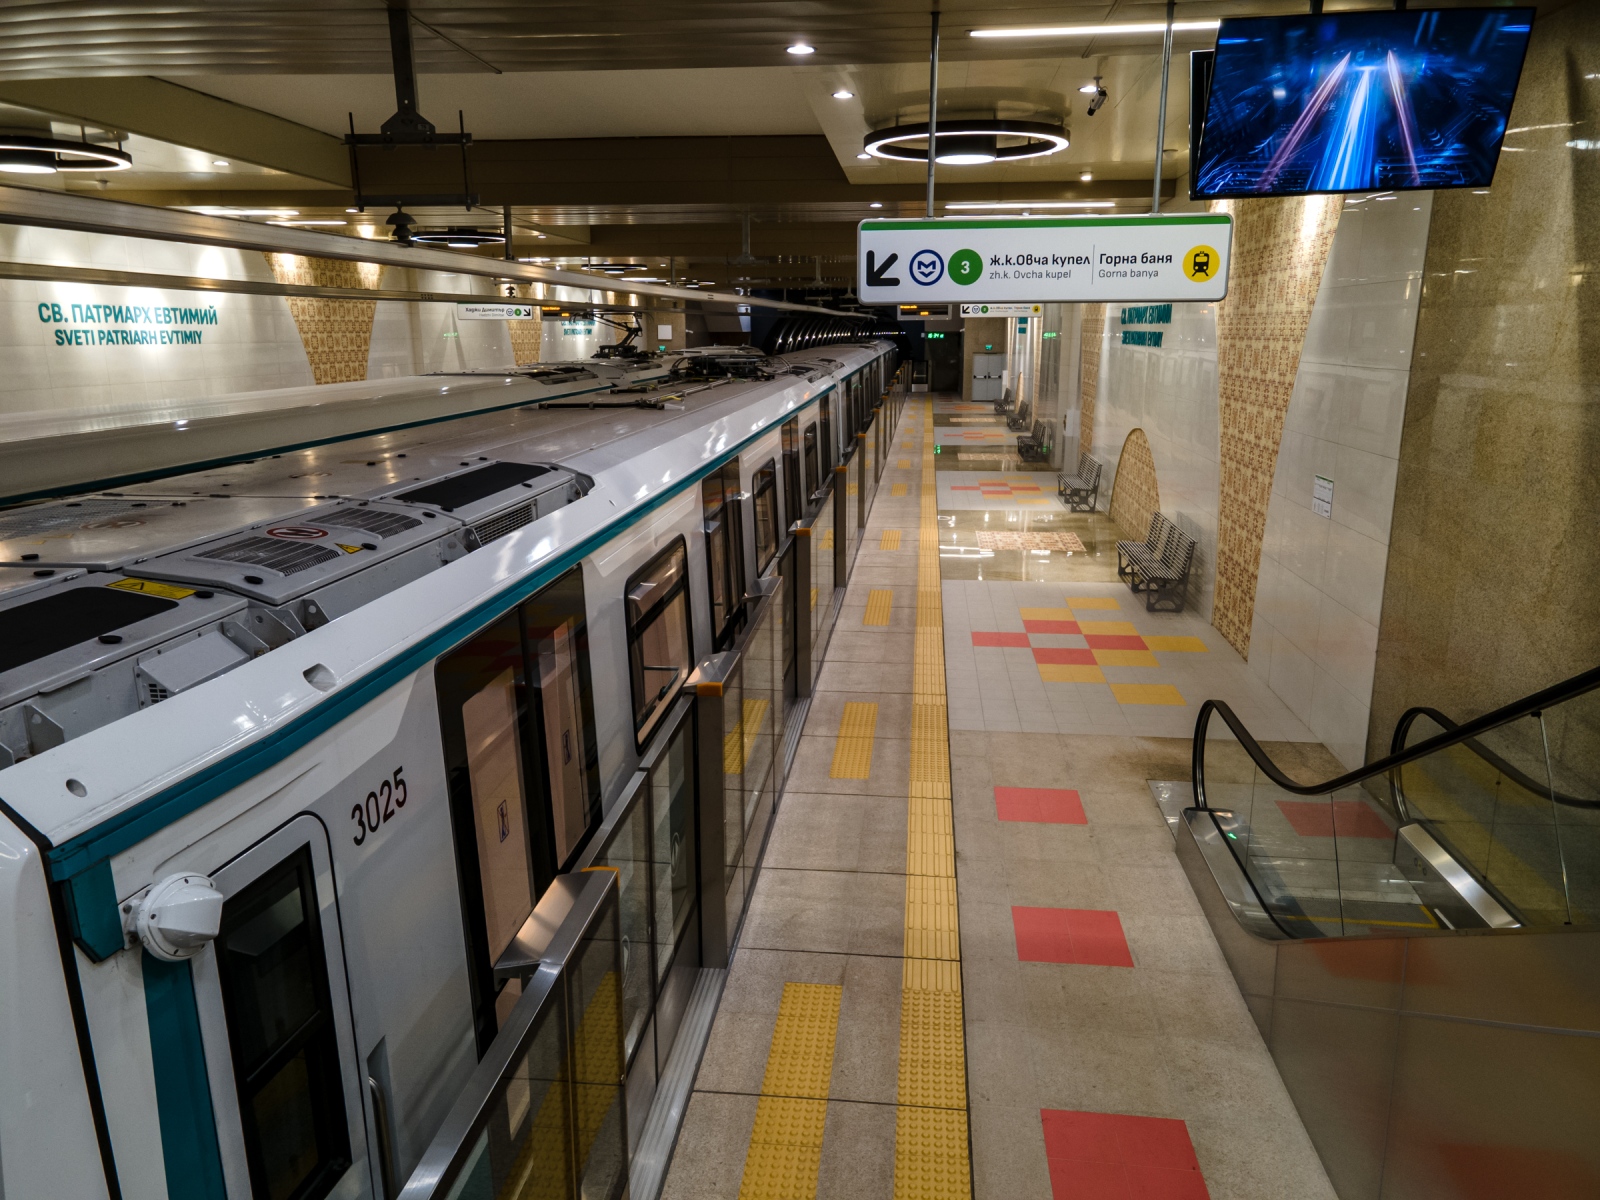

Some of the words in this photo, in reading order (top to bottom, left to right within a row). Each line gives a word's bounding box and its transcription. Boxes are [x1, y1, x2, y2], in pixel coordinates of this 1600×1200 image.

[1052, 253, 1091, 268] купел
[1099, 253, 1138, 267] Горна
[1141, 252, 1173, 264] баня
[960, 260, 971, 275] 3
[989, 270, 1011, 280] zh.k.
[1013, 269, 1043, 279] Ovcha
[1045, 269, 1072, 280] kupel
[1098, 269, 1128, 278] Gorna
[1130, 268, 1159, 280] banya
[38, 302, 69, 324] СВ.
[71, 303, 153, 324] ПАТРИАРХ
[154, 305, 218, 326] ЕВТИМИЙ
[54, 329, 96, 346] SVETI
[98, 329, 158, 345] PATRIARH
[160, 330, 203, 345] EVTIMIY
[351, 765, 408, 847] 3025
